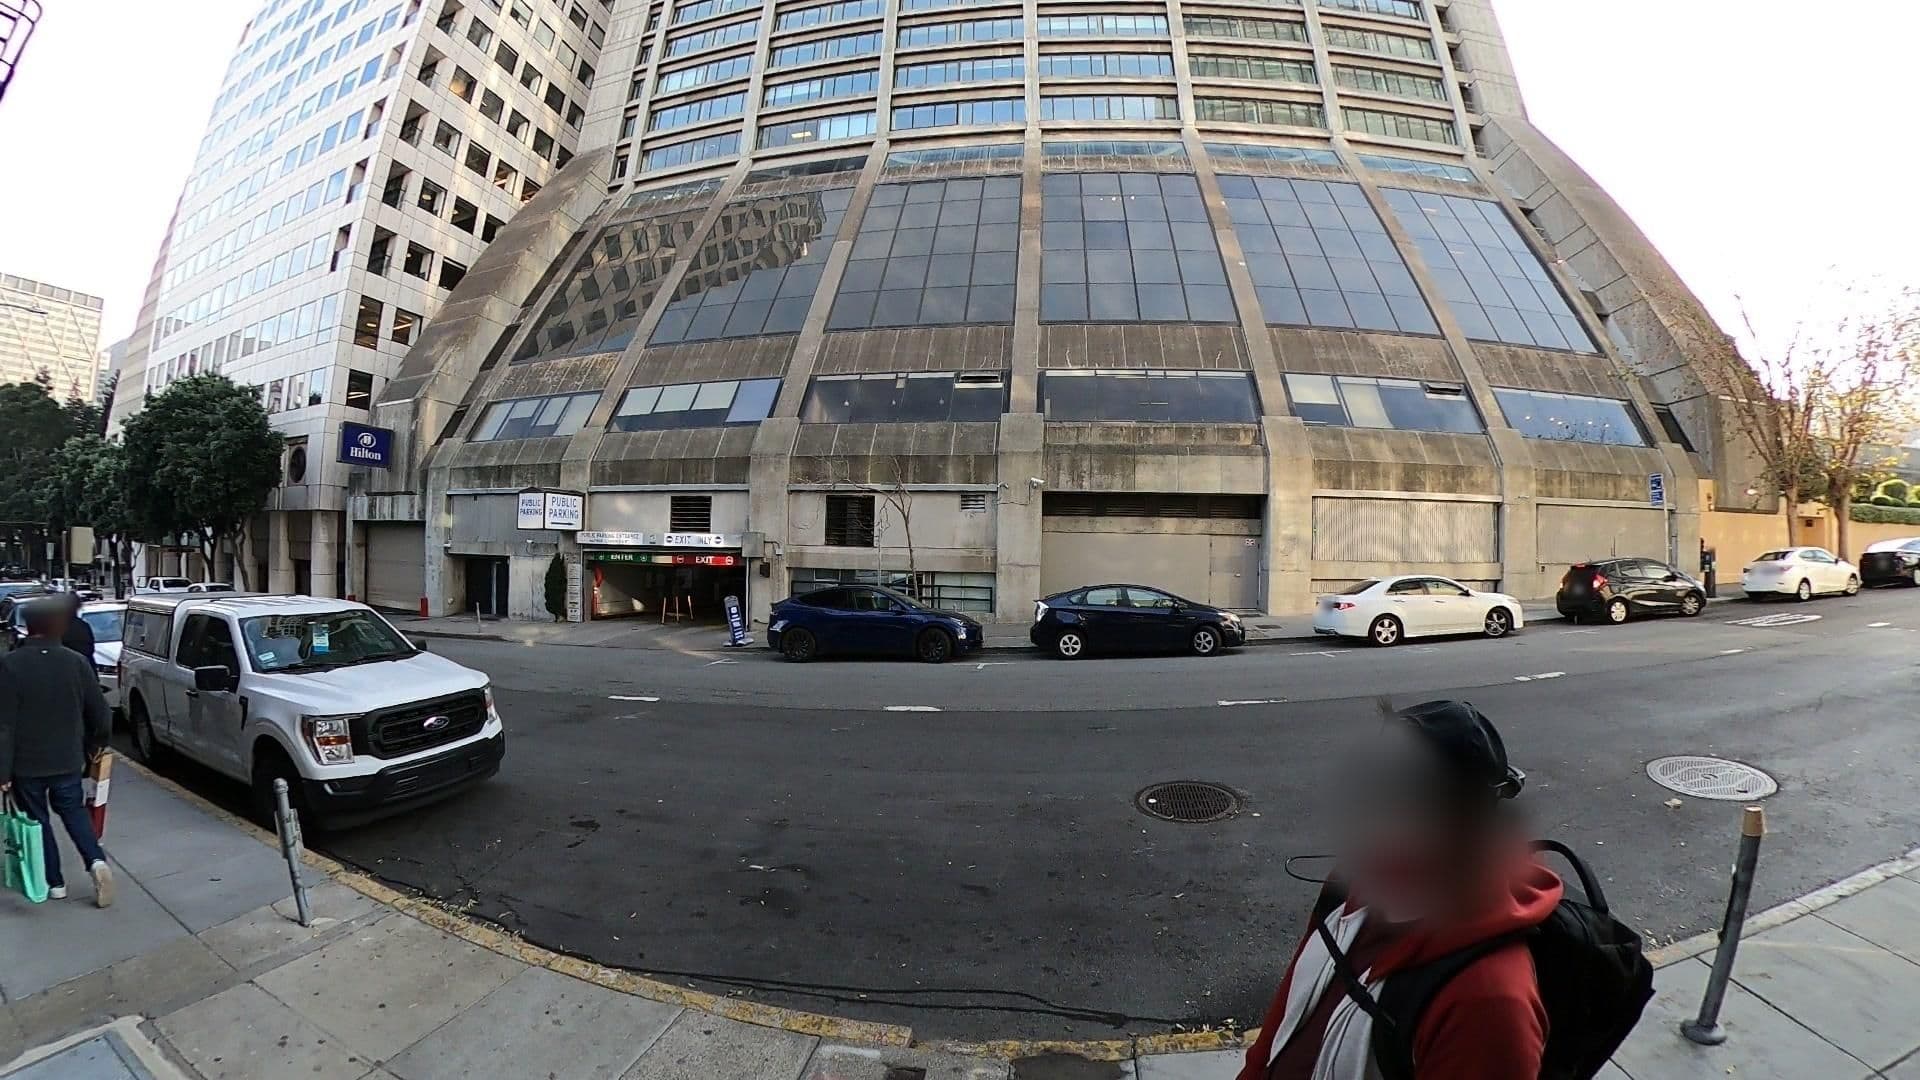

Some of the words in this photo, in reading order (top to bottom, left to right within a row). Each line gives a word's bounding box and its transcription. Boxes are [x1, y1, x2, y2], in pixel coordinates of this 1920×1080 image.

[350, 446, 381, 460] Hilton
[521, 498, 541, 507] PUBLIC
[551, 496, 577, 508] PUBLIC
[520, 507, 542, 515] PARKING
[549, 508, 579, 519] PARKING
[675, 535, 692, 544] EXIT
[696, 556, 713, 564] EXIT
